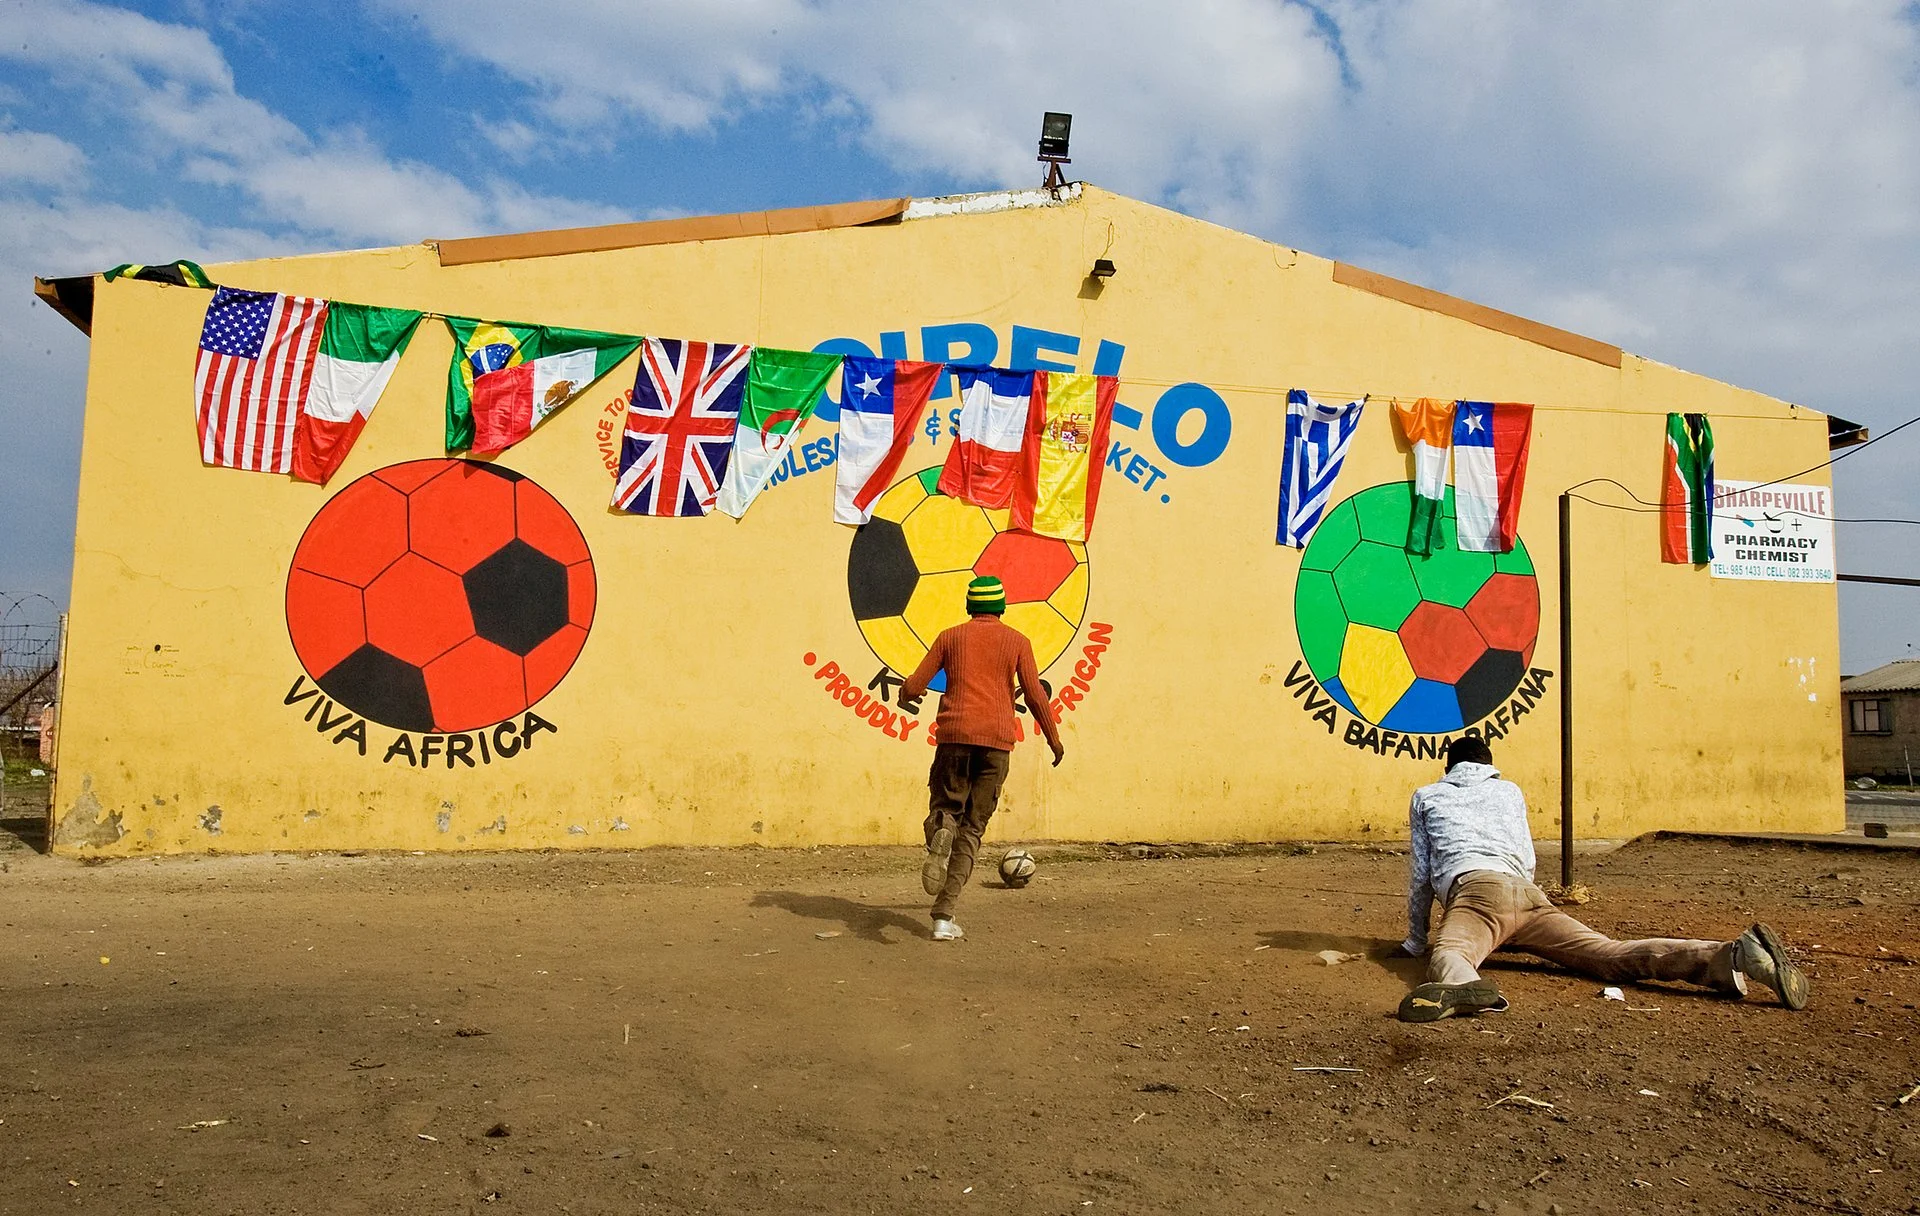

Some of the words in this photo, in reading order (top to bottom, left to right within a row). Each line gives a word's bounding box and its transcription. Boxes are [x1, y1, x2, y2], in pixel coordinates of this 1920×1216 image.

[604, 397, 625, 417] TO
[1714, 484, 1826, 516] SHARPEVILLE
[1724, 534, 1818, 549] PHARMACY
[1735, 549, 1808, 563] CHEMIST
[1713, 564, 1729, 575] TEL:
[1745, 566, 1761, 576] 1433
[1766, 567, 1786, 577] CELL:
[814, 661, 919, 741] PROUDLY
[1283, 660, 1337, 734] VIVA
[1343, 719, 1452, 760] BAFANA
[284, 674, 367, 756] VIVA
[383, 711, 558, 769] AFRICA
